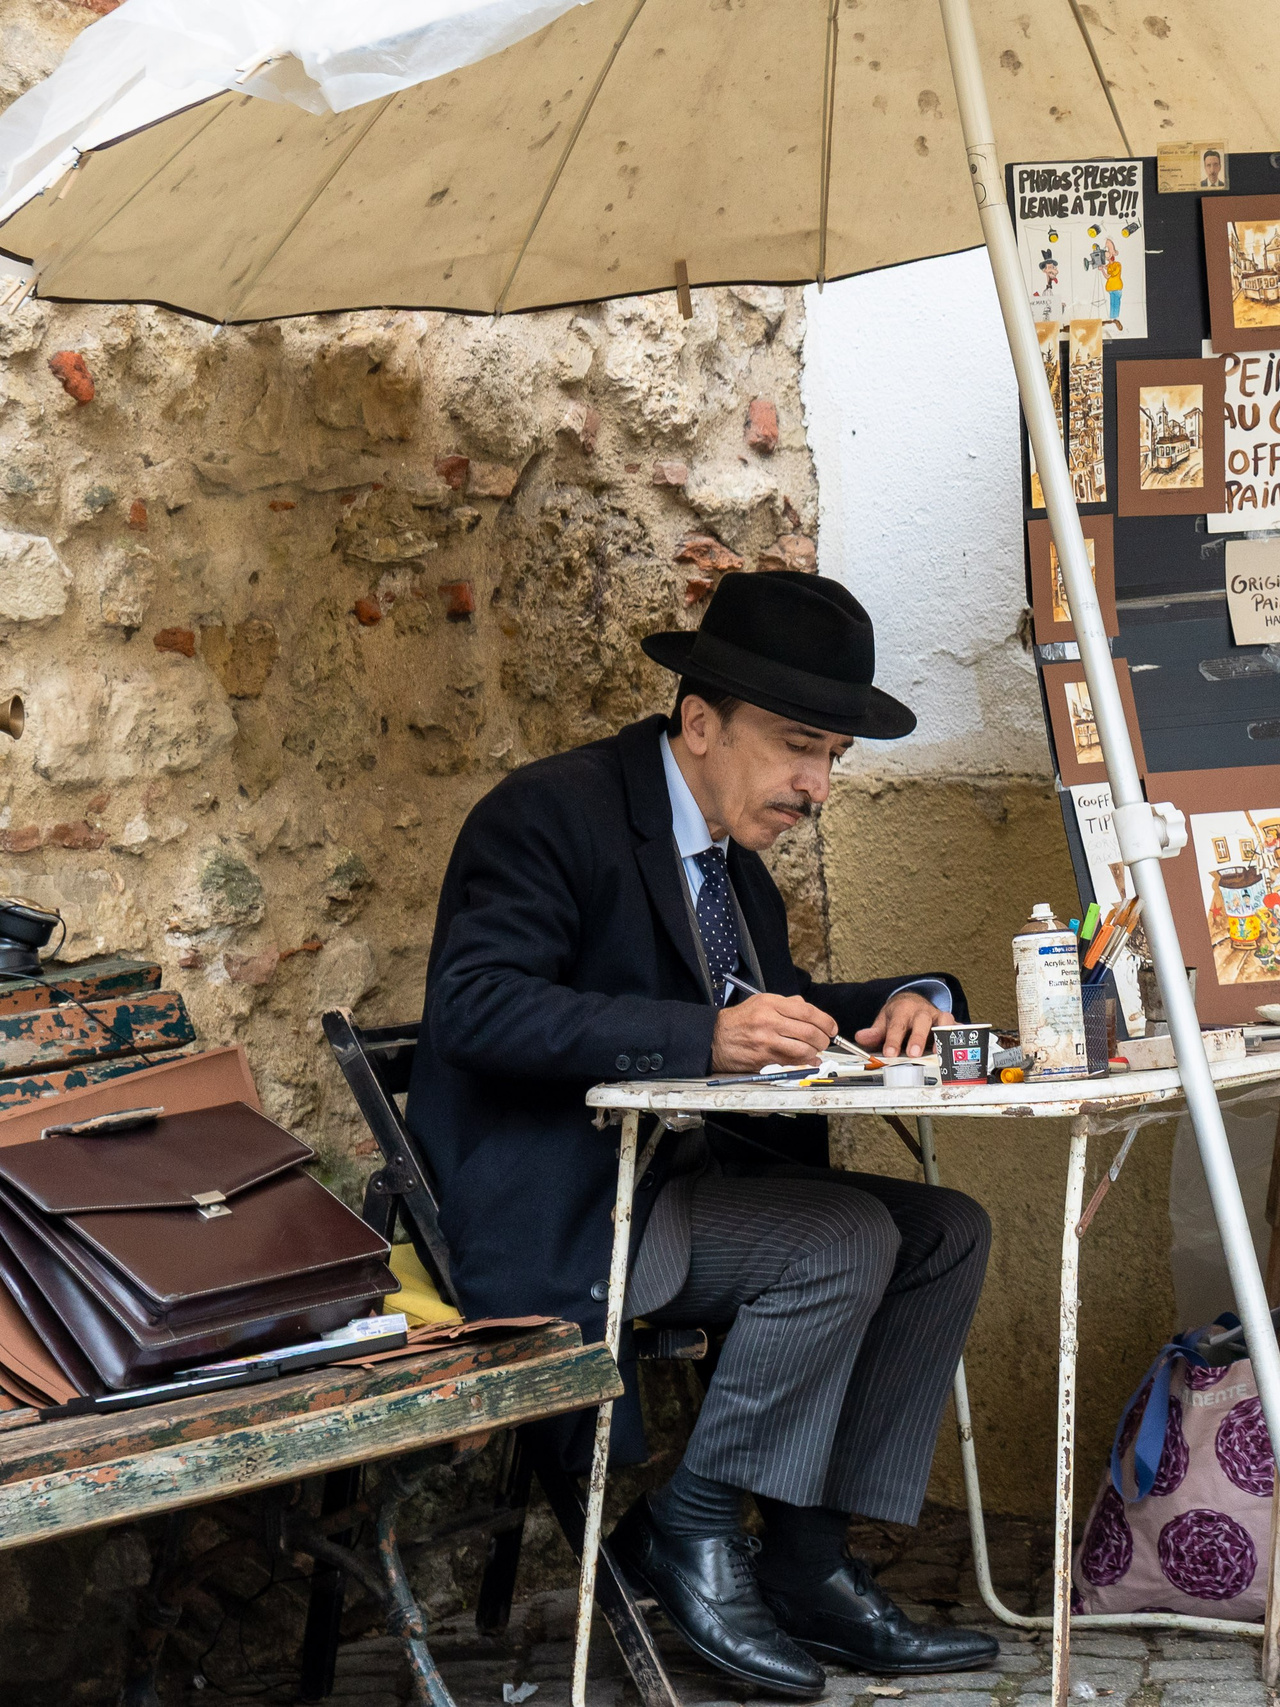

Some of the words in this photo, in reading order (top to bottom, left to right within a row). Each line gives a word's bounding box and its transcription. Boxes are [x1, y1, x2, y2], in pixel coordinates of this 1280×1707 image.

[1083, 164, 1138, 189] PLEASE
[1019, 194, 1070, 220] LEAVE
[1070, 192, 1084, 215] A
[1078, 793, 1110, 809] COOFF
[1085, 814, 1111, 834] TIP
[1044, 959, 1066, 968] Acrylic
